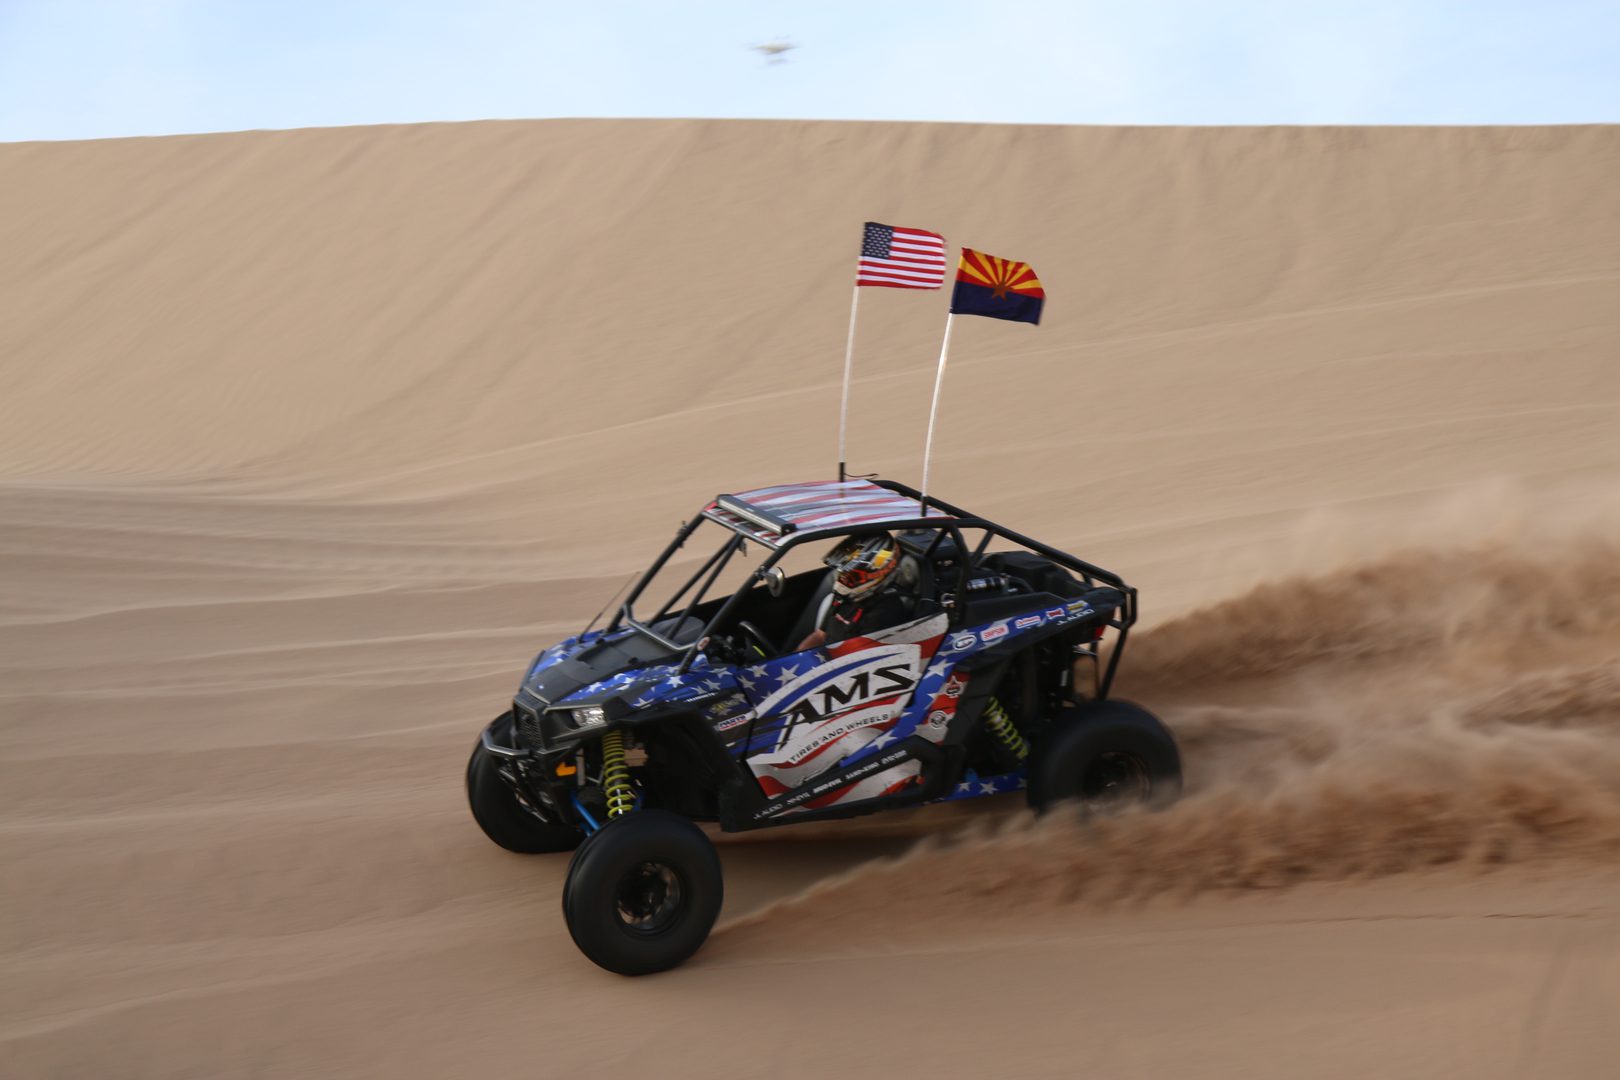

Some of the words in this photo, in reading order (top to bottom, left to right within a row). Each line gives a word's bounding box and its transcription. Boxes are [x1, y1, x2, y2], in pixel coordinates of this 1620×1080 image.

[778, 664, 916, 749] AMS
[790, 741, 820, 762] TIRES
[822, 727, 844, 742] AND
[847, 714, 889, 731] WHEELS
